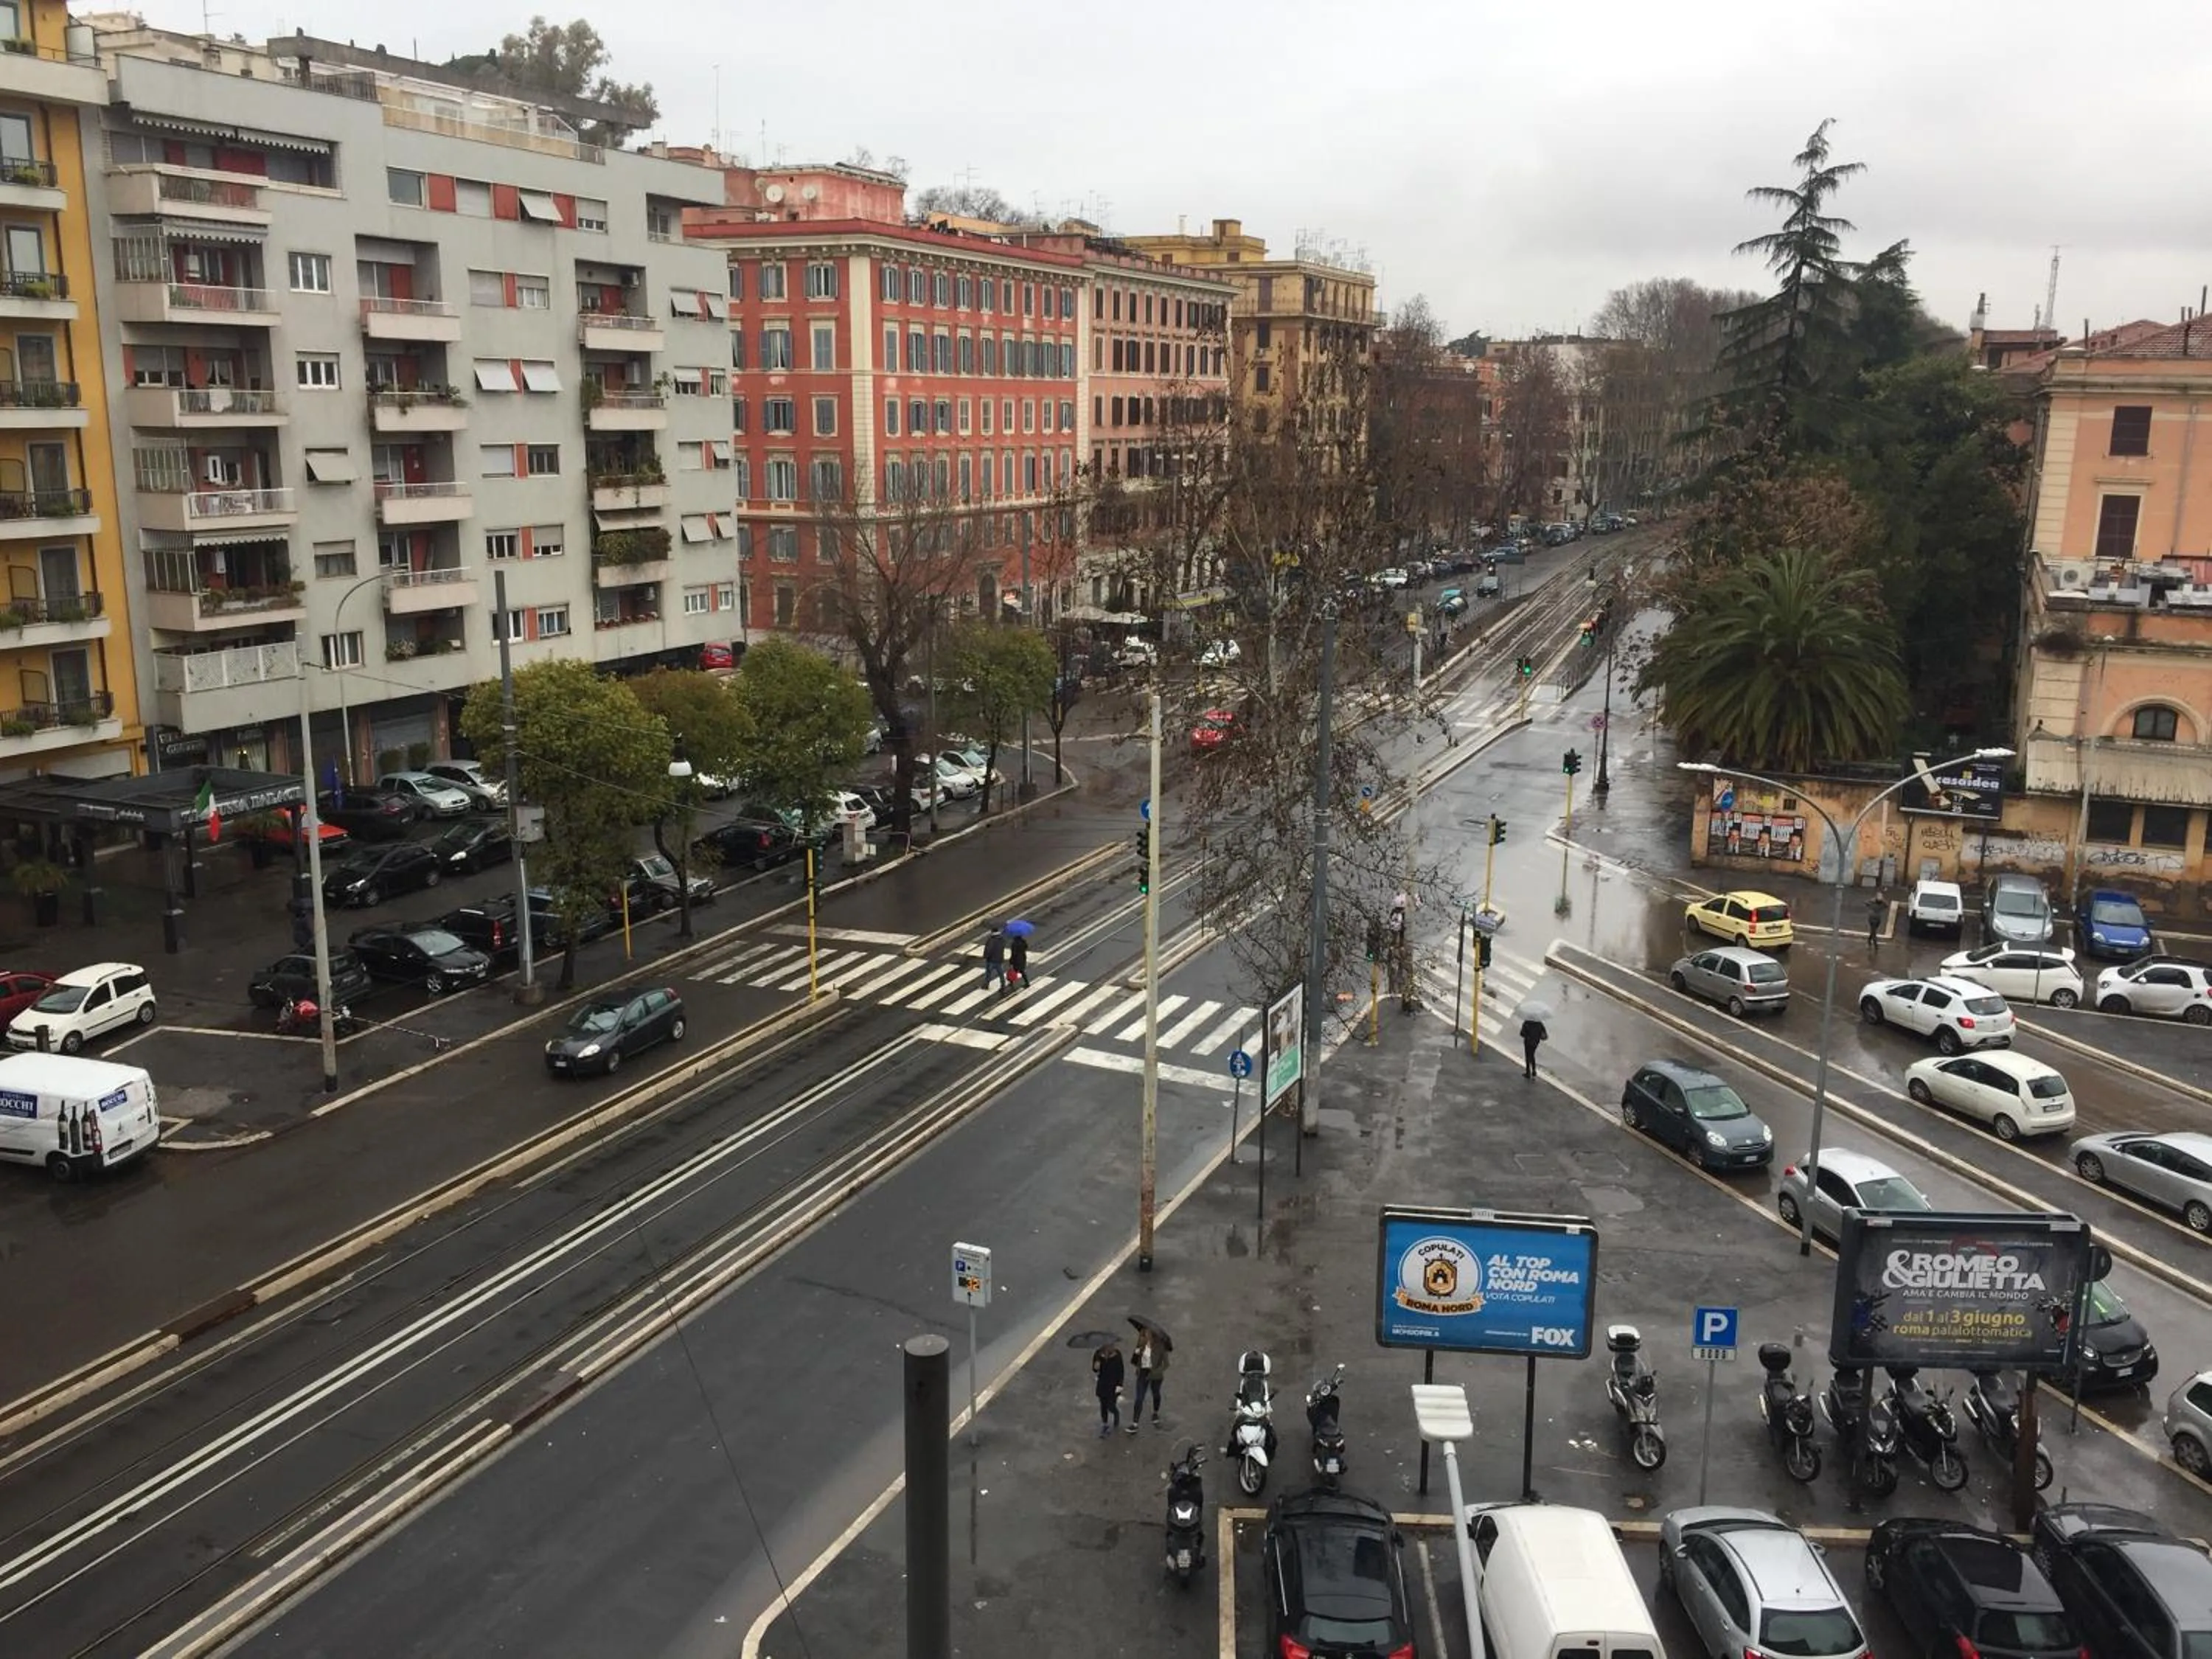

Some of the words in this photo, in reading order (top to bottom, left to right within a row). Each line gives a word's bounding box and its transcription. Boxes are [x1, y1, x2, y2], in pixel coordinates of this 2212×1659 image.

[1935, 776, 2000, 789] casaidea
[0, 1099, 34, 1111] OCCHI
[1418, 1242, 1465, 1259] COPULATI
[1487, 1254, 1512, 1267] AL
[1517, 1256, 1551, 1269] TOP
[1912, 1255, 2020, 1273] ROMEO
[1488, 1267, 1526, 1280] CON
[1528, 1269, 1579, 1284] ROMA
[1910, 1272, 2045, 1290] GIULIETTA
[1486, 1279, 1537, 1292] NORD
[1486, 1293, 1510, 1301] VOTA
[1512, 1294, 1555, 1304] COPULATI
[1936, 1290, 1976, 1299] CAMBIA
[1978, 1291, 1989, 1299] IL
[1989, 1291, 2029, 1301] MONDO
[1406, 1299, 1439, 1313] ROMA
[1441, 1301, 1474, 1313] NORD
[1902, 1310, 1923, 1323] dal
[1926, 1309, 1934, 1323] 1
[1936, 1311, 1949, 1324] al
[1950, 1310, 1961, 1323] 3
[1963, 1310, 2026, 1326] giugno
[1703, 1312, 1729, 1341] P
[1893, 1324, 1930, 1335] roma
[1931, 1324, 2033, 1339] palalottomatica
[1531, 1326, 1576, 1347] FOX
